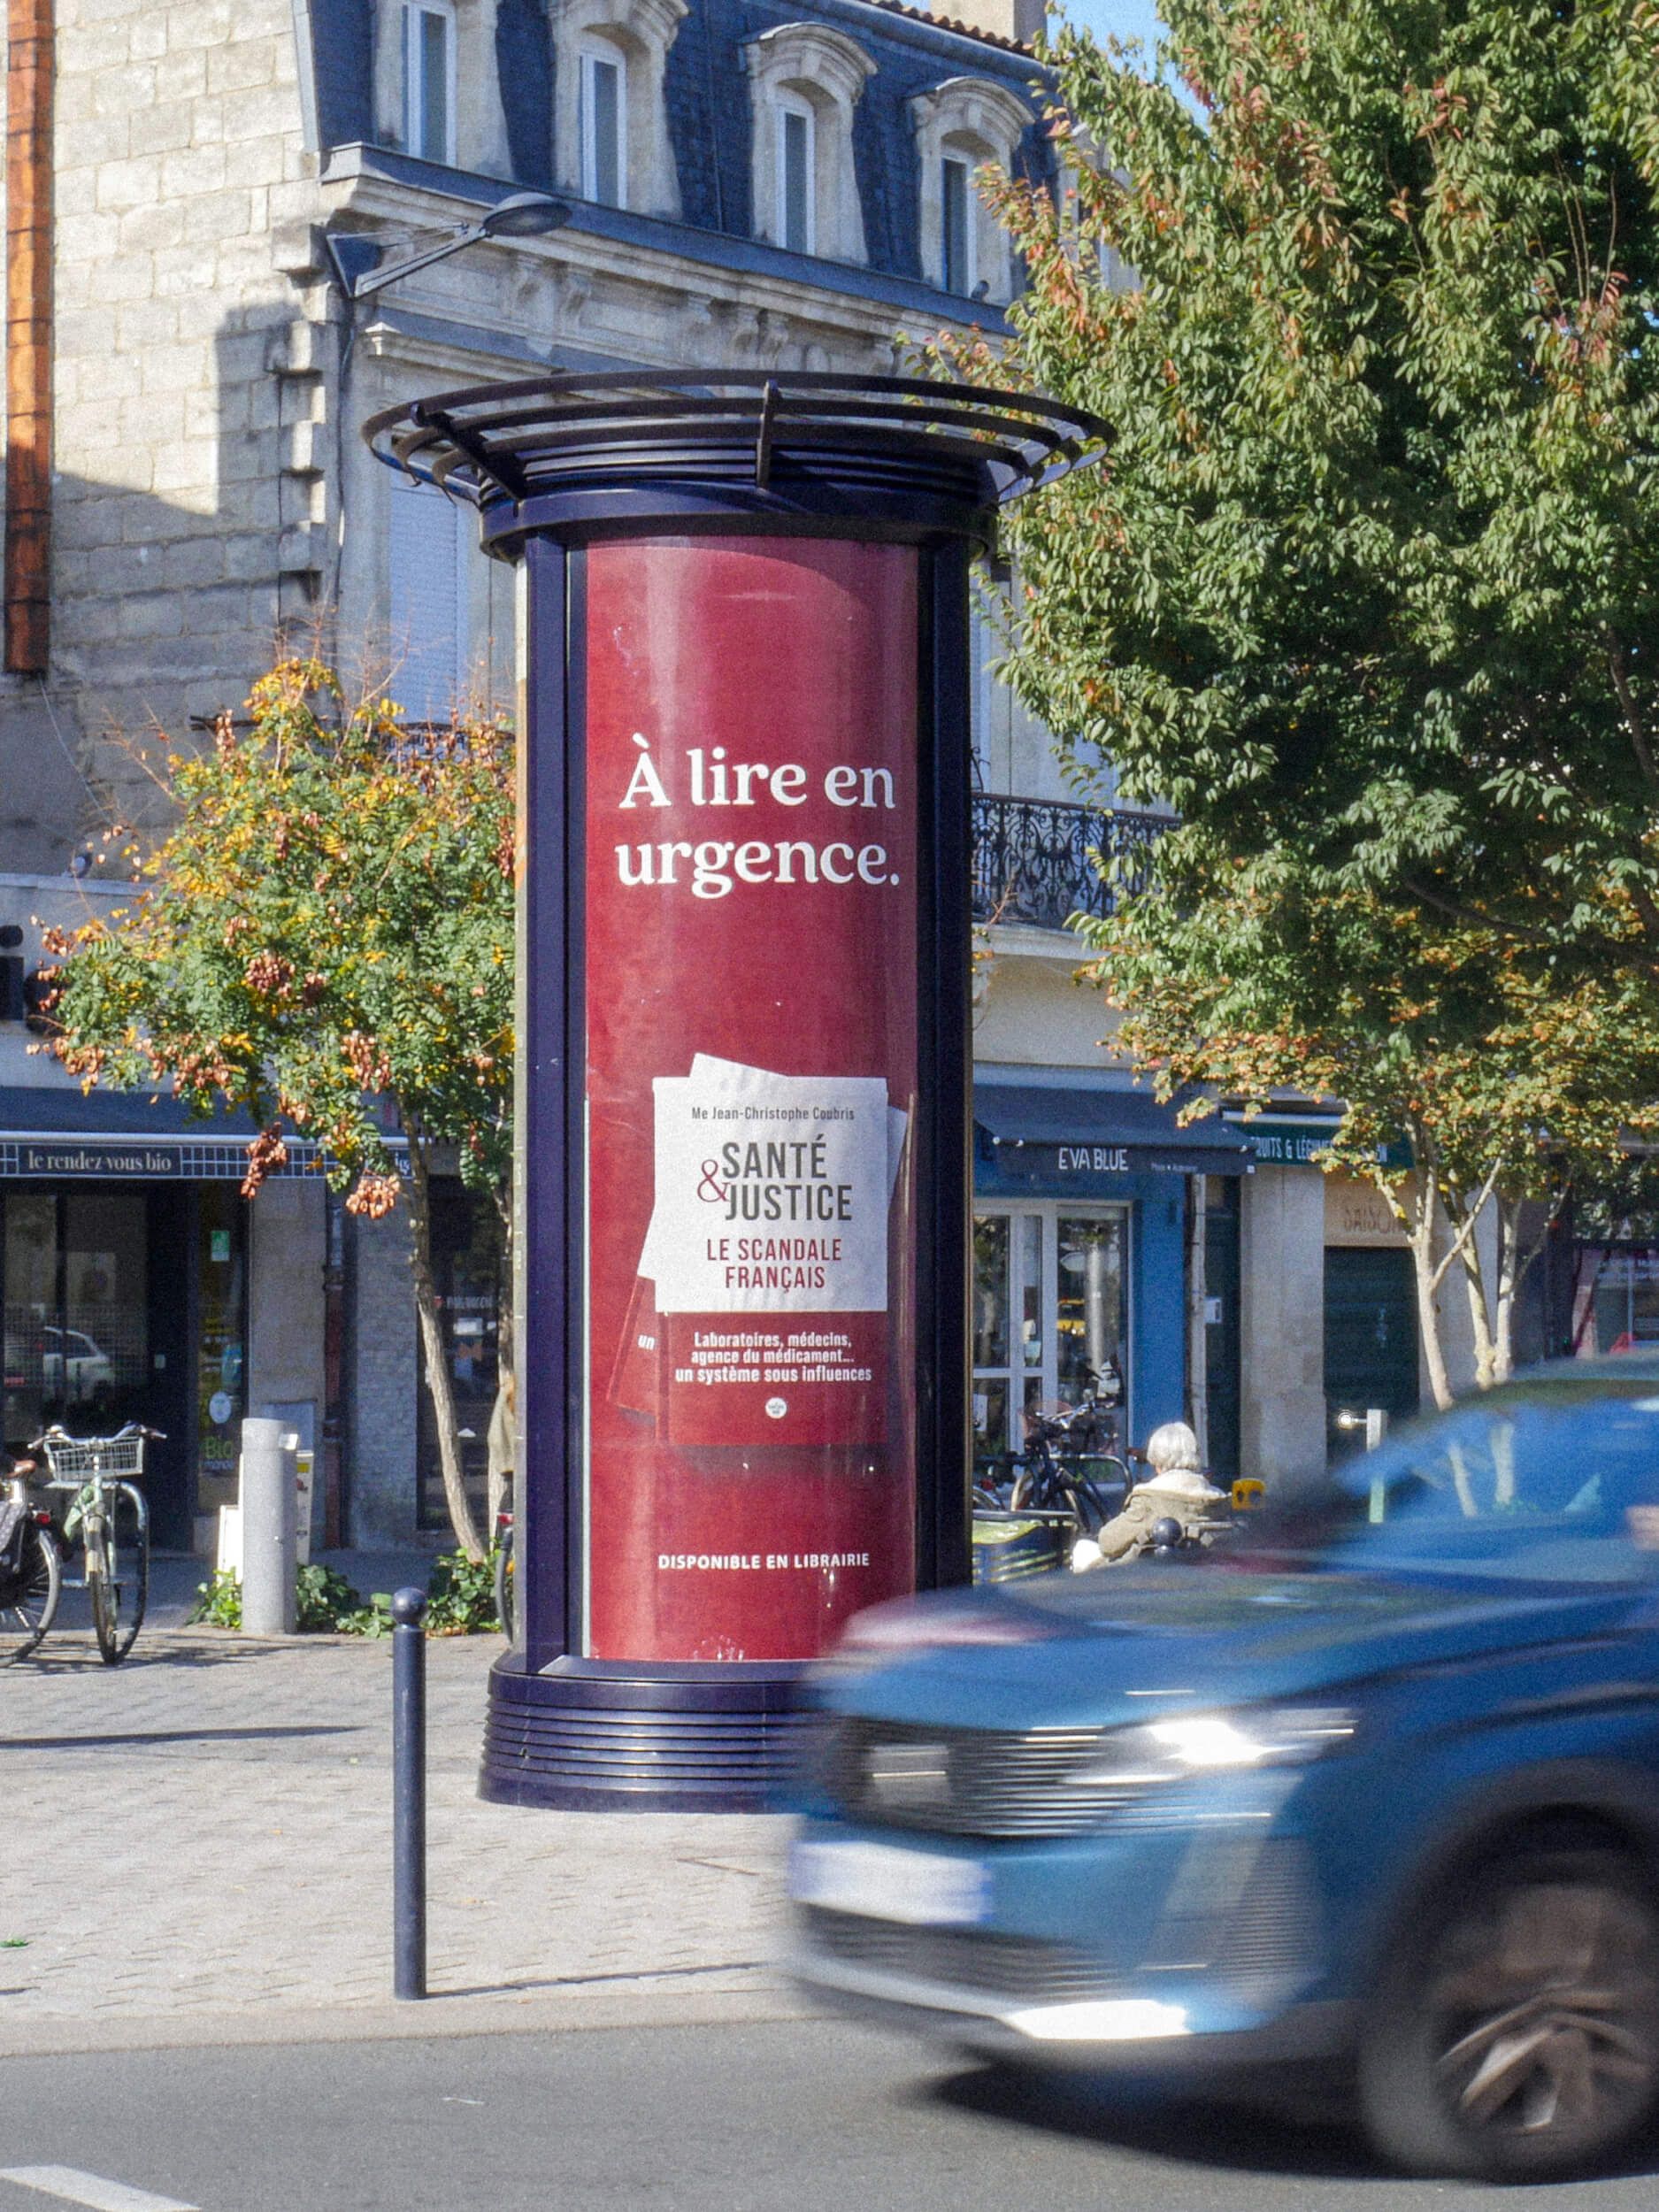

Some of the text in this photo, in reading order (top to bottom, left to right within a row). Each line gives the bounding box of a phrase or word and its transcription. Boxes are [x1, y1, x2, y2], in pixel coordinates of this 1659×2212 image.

[618, 732, 895, 809] À lire en
[615, 841, 900, 900] urgence.
[692, 1107, 855, 1123] Me Jean-Christophe Coubris
[28, 1149, 44, 1171] le
[145, 1152, 172, 1171] bio
[722, 1133, 826, 1179] SANTÉ
[1057, 1147, 1090, 1171] EVA
[1093, 1148, 1129, 1171] BLUE
[696, 1159, 732, 1203] &
[725, 1184, 852, 1222] JUSTICE
[707, 1239, 842, 1262] LE SCANDALE
[725, 1266, 826, 1294] FRANÇAIS
[637, 1333, 656, 1350] un
[694, 1331, 852, 1348] Laboratoires, médecins,
[691, 1349, 739, 1364] agence
[743, 1348, 760, 1363] du
[675, 1365, 872, 1386] un système sous influences
[657, 1553, 870, 1570] DISPONIBLE EN LIBRAIRIE
